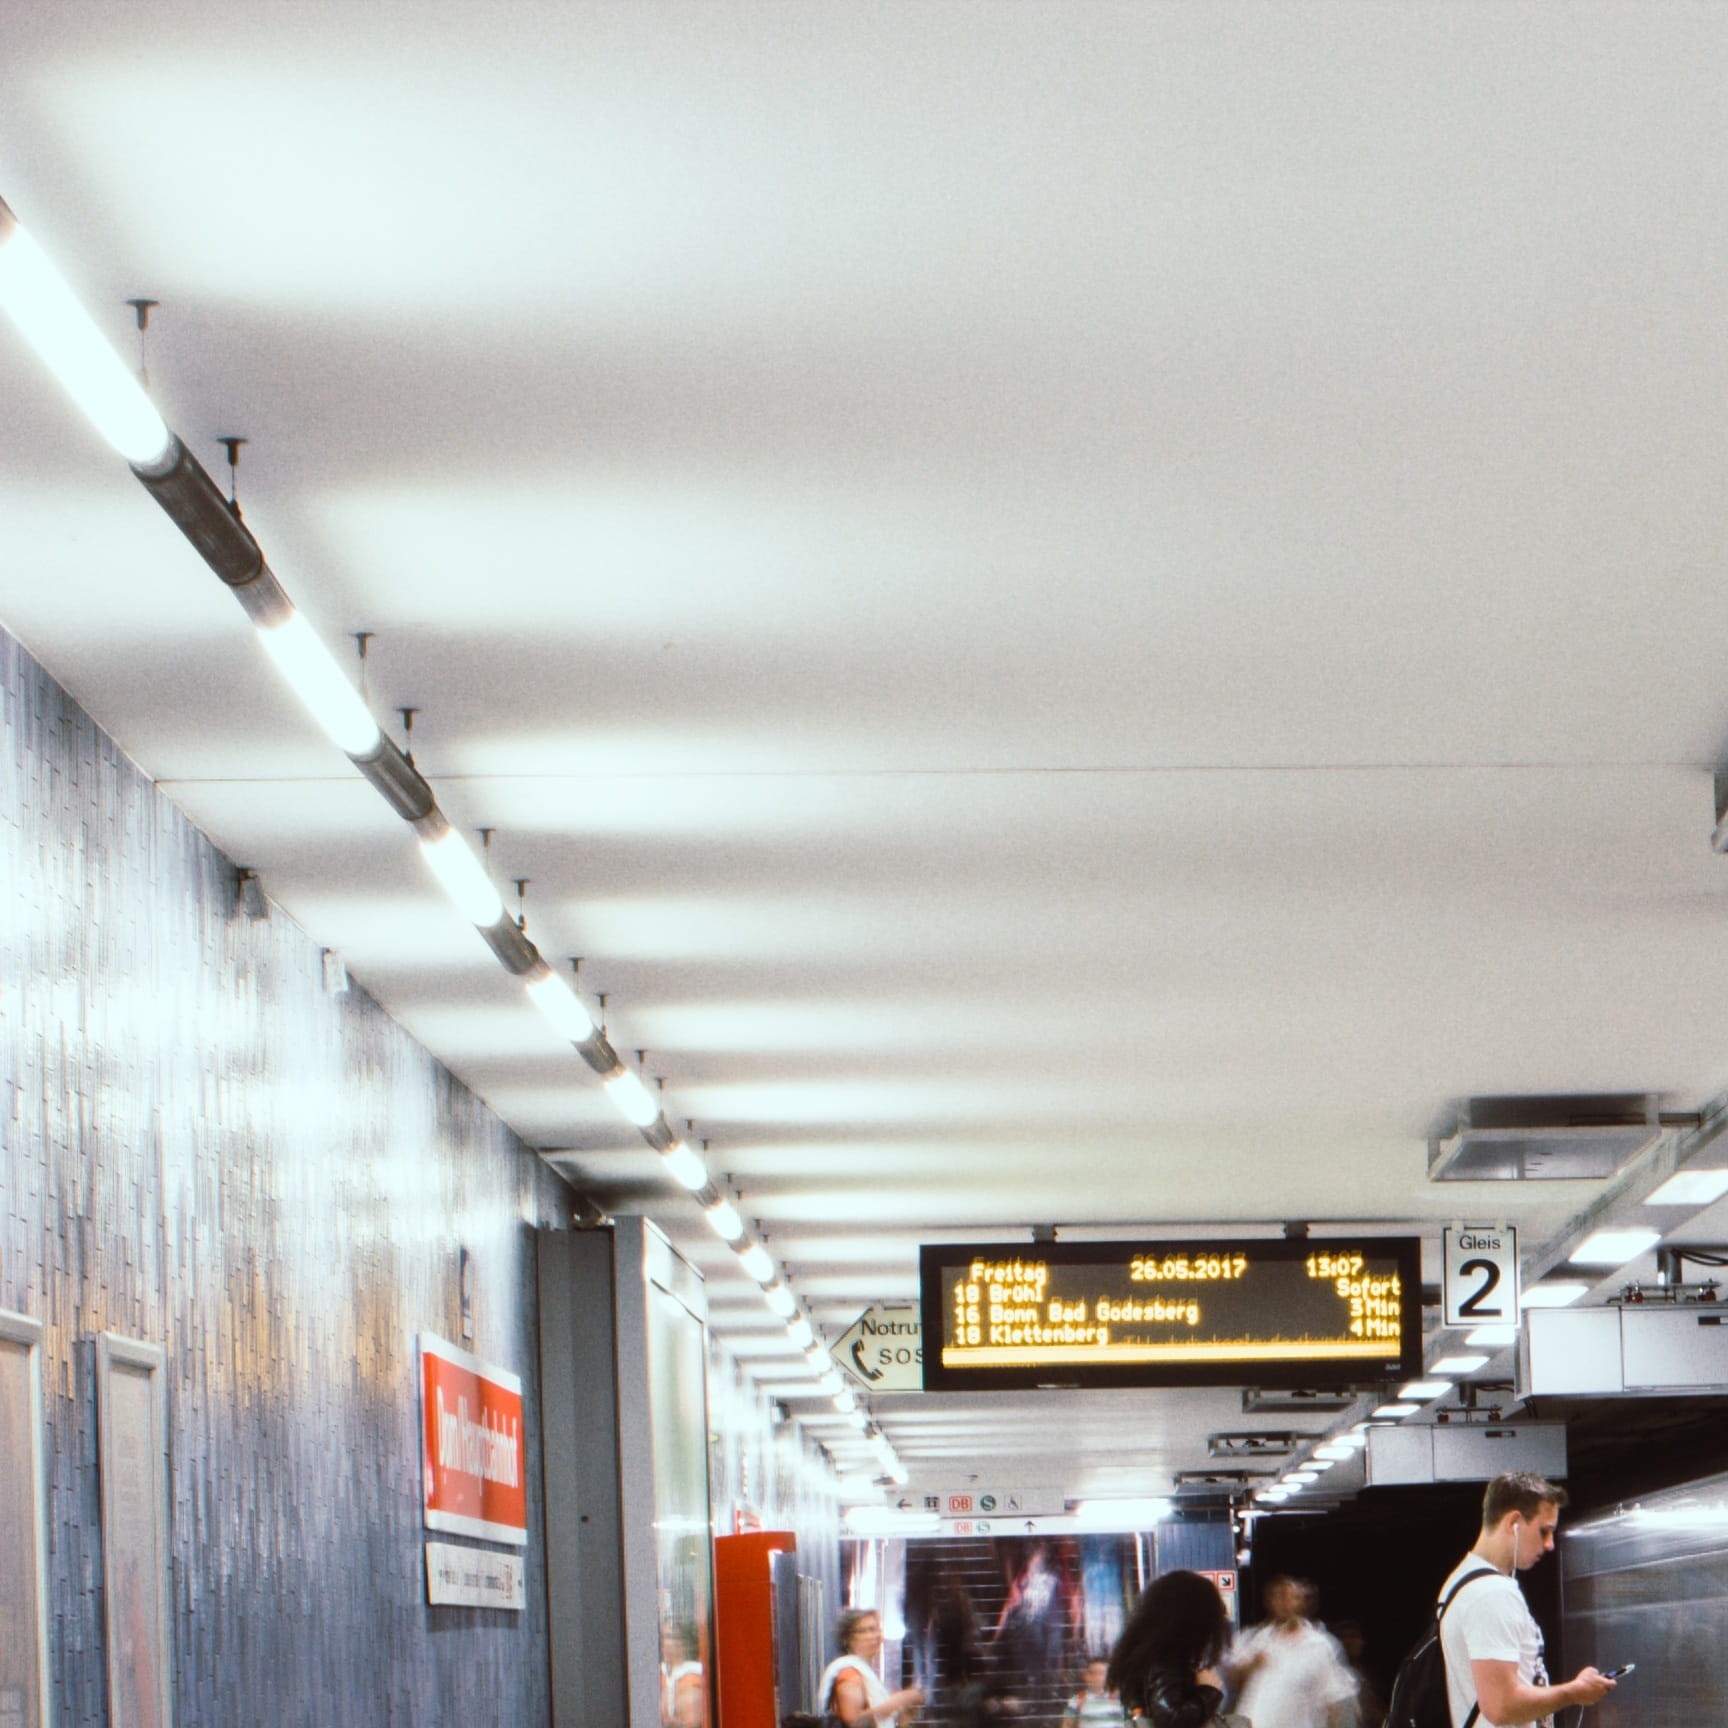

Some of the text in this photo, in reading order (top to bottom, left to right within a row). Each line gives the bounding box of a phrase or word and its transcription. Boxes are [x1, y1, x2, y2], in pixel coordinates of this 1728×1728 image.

[1459, 1234, 1501, 1249] Gleis
[970, 1256, 1363, 1287] Freitag 26.05.2017 13:07
[955, 1283, 980, 1304] 18
[1336, 1276, 1400, 1298] Sofort
[1458, 1258, 1502, 1317] 2
[955, 1298, 1400, 1325] 16 Bonn Bad Godesberg 3 Min
[861, 1319, 920, 1336] Notru
[955, 1317, 1400, 1346] 18 Klettenberg 4 Min
[950, 1498, 970, 1510] DB
